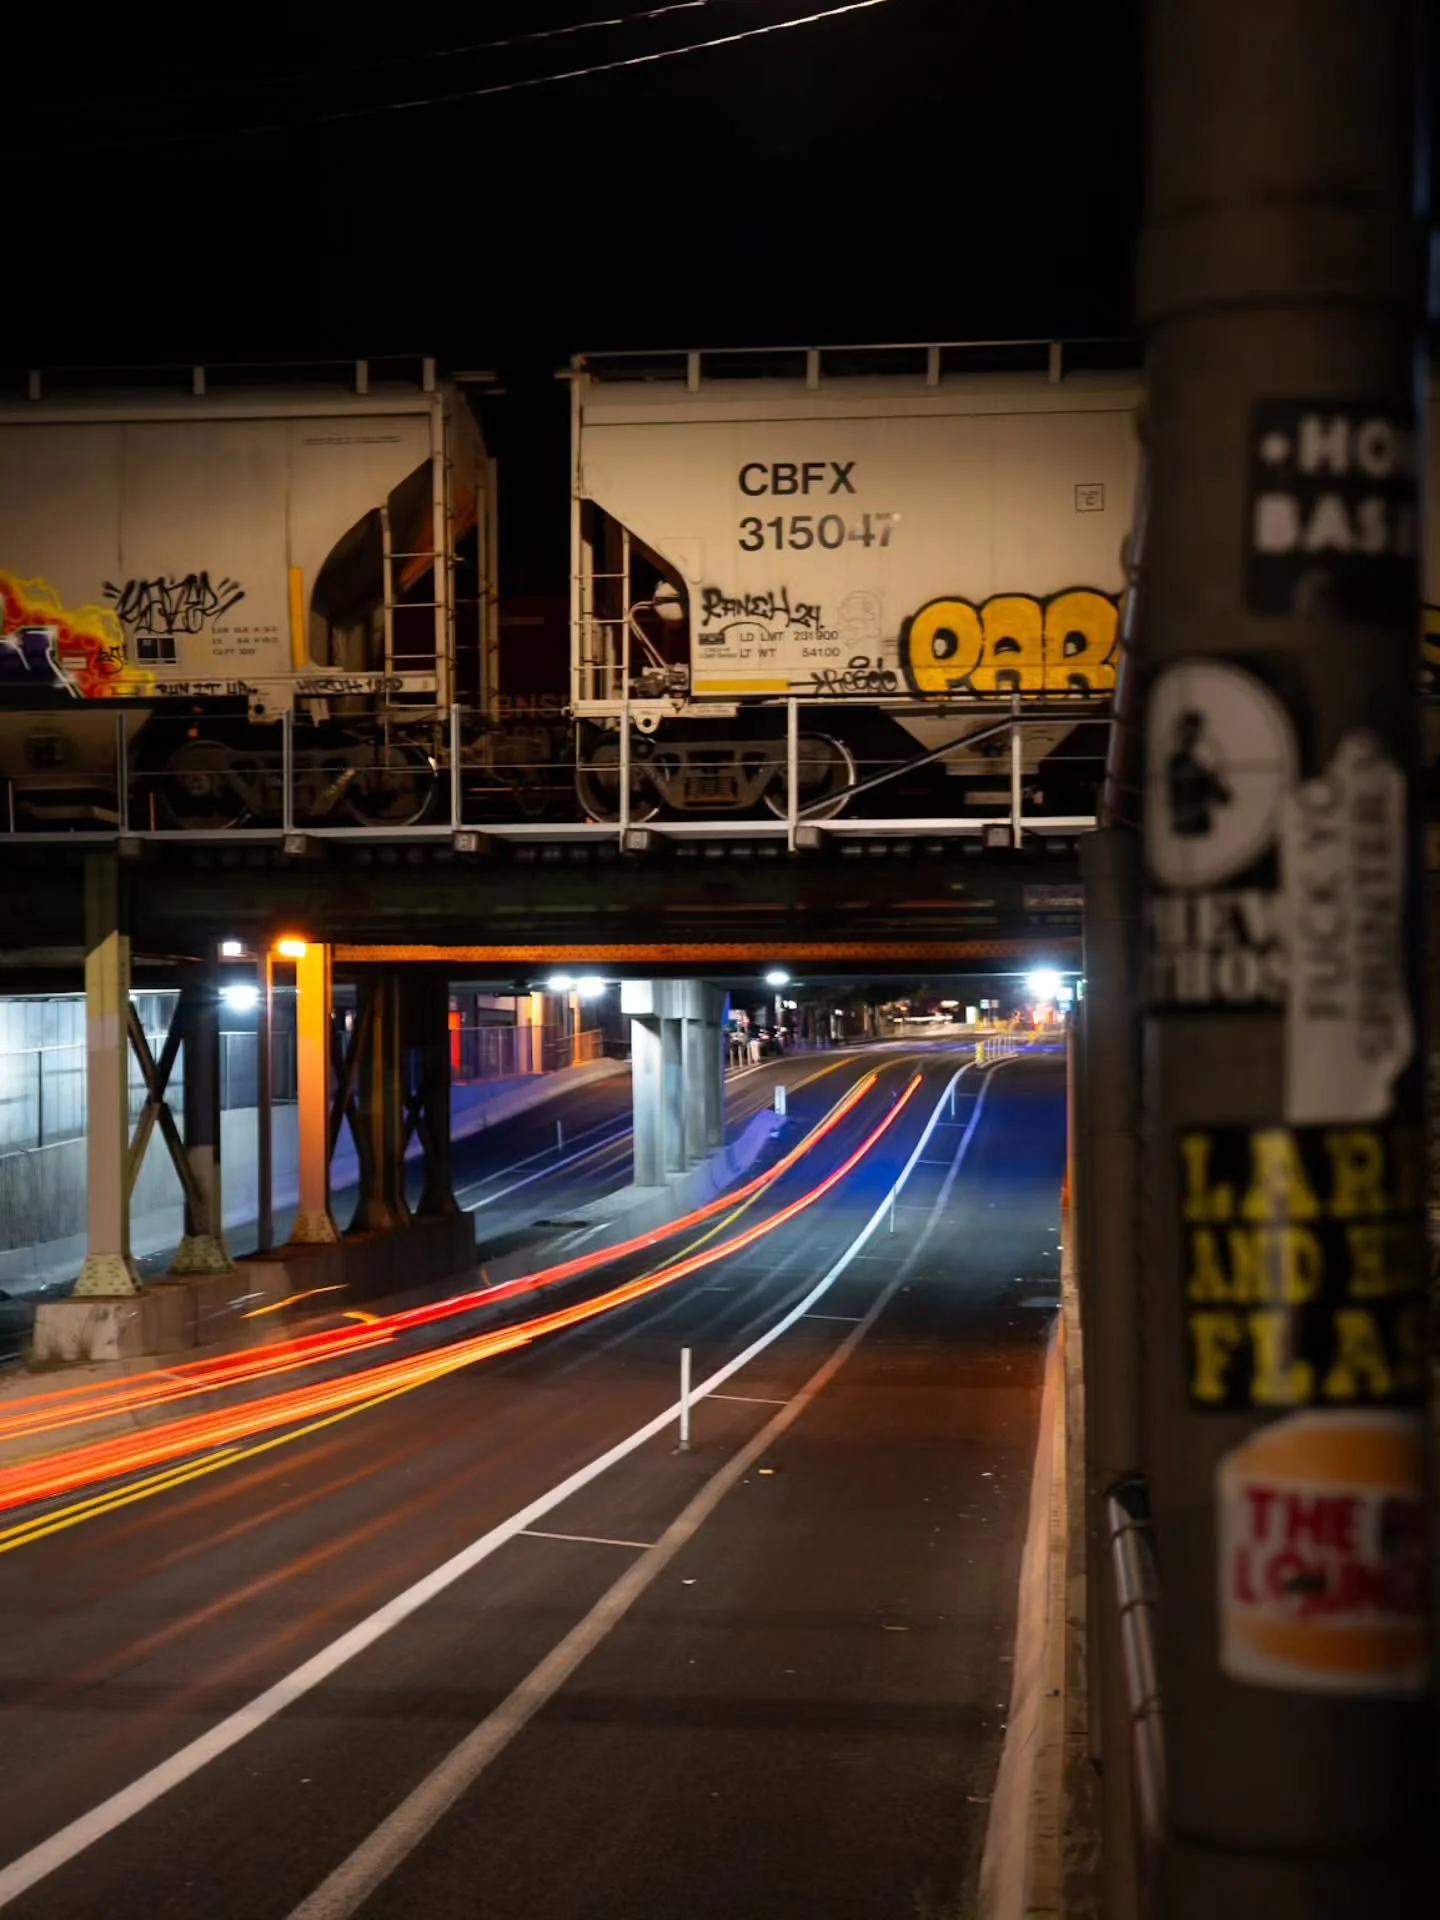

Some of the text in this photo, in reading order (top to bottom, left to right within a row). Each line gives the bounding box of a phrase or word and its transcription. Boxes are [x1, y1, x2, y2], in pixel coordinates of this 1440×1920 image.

[1298, 412, 1397, 481] HO
[738, 462, 857, 496] CBFX
[738, 513, 895, 552] 315047
[739, 631, 755, 642] LD
[760, 630, 785, 642] LMT
[739, 648, 752, 659] LT
[757, 647, 777, 658] WT
[802, 647, 840, 658] 54100
[1180, 1128, 1412, 1223] LAR
[1243, 1486, 1357, 1553] THE
